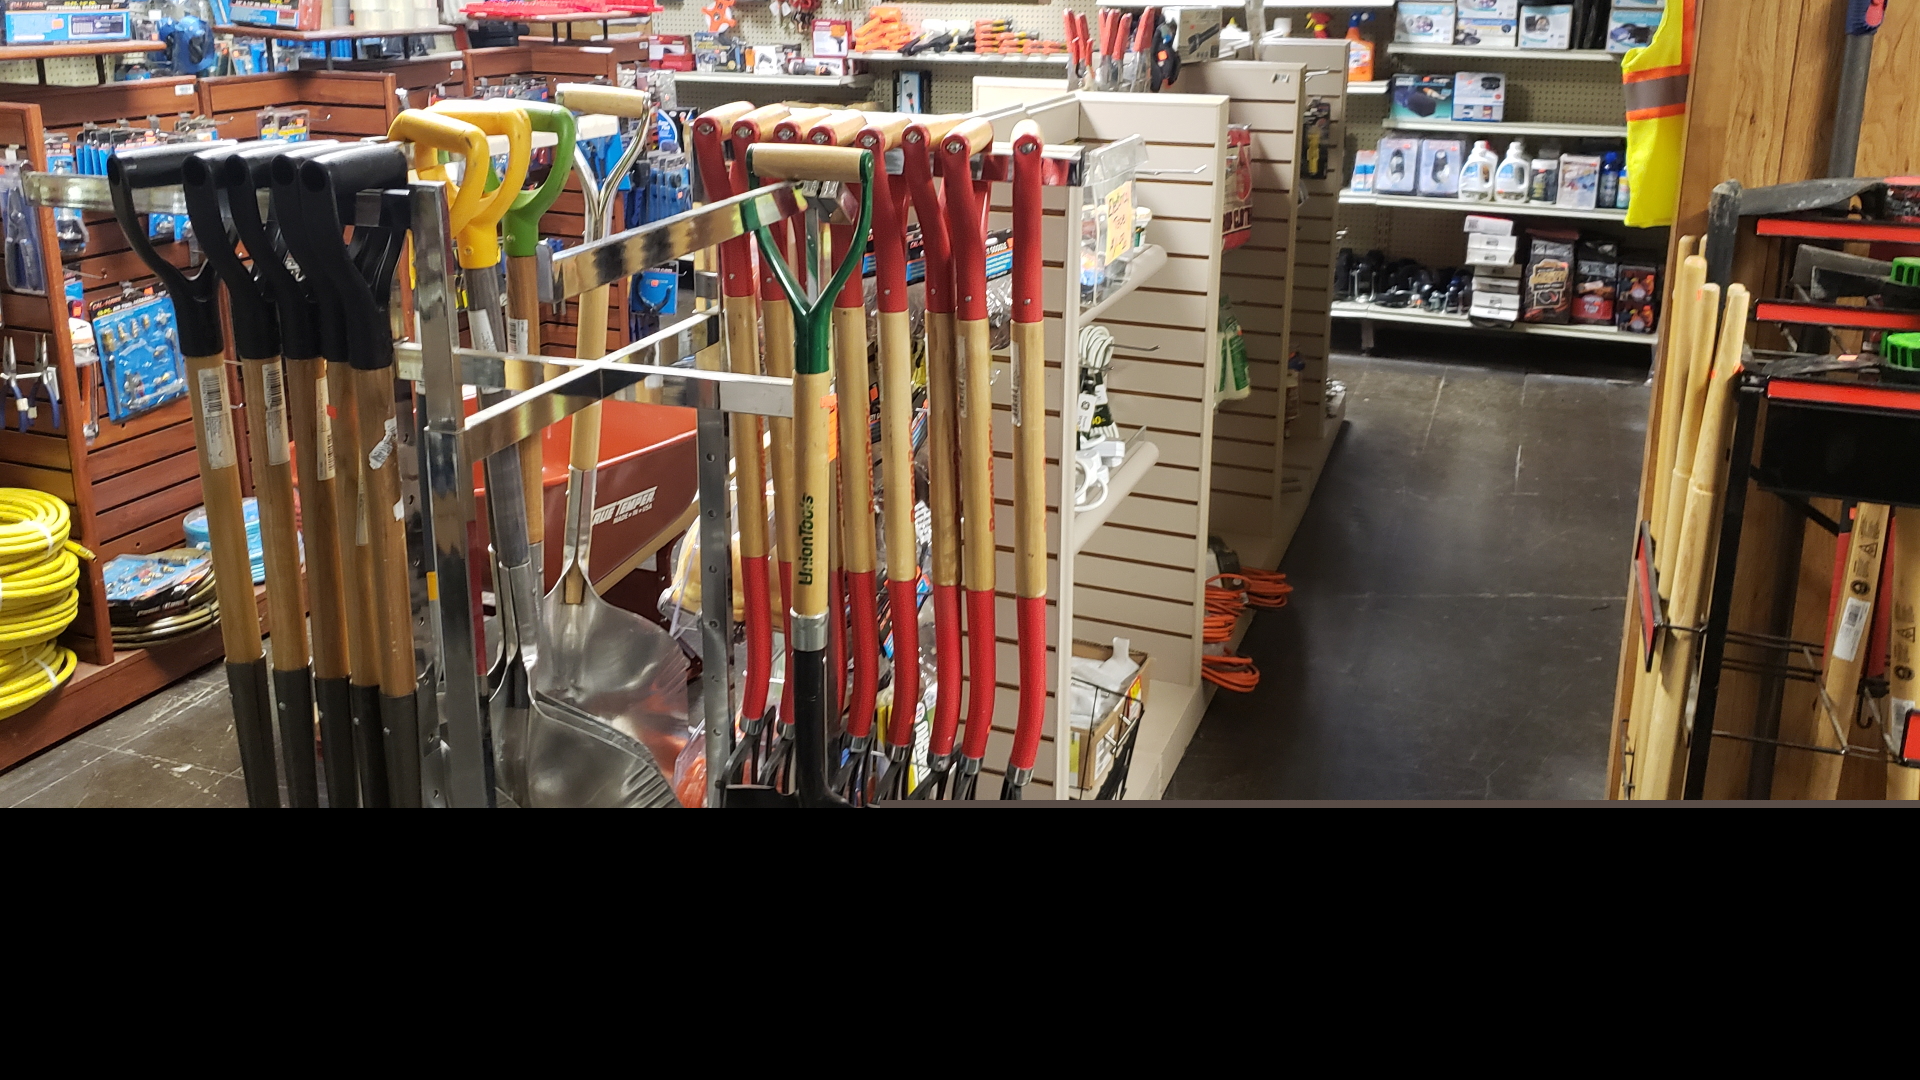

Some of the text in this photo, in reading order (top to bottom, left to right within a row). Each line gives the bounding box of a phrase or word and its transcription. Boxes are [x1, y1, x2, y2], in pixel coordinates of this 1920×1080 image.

[592, 485, 658, 527] RUE TEMPER
[798, 492, 814, 585] UnionTools
